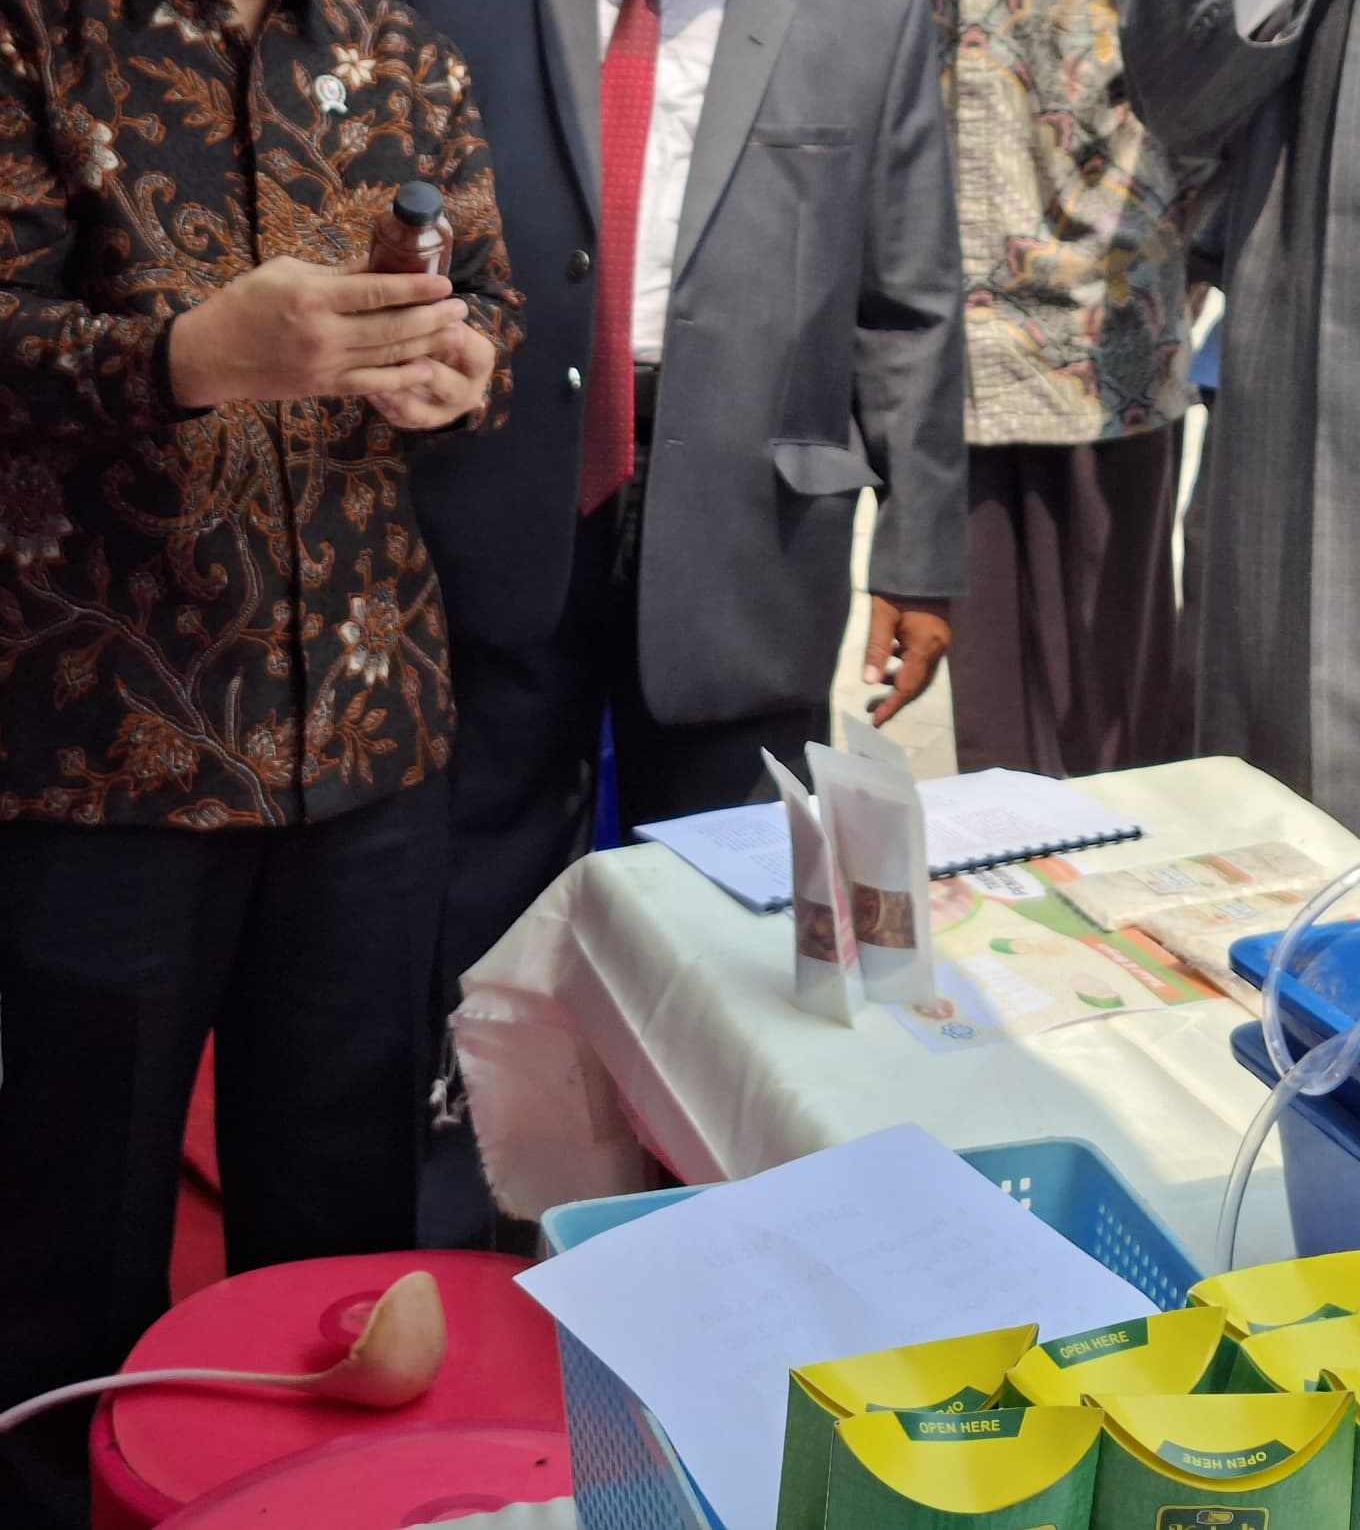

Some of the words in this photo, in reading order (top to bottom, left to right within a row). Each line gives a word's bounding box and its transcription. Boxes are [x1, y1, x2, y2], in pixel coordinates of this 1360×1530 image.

[1059, 1339, 1091, 1359] OPEN
[1091, 1330, 1130, 1351] HERE
[918, 1421, 958, 1435] OPEN
[959, 1419, 1001, 1434] HERE
[1181, 1452, 1223, 1471] HERE
[1226, 1450, 1268, 1470] OPEN
